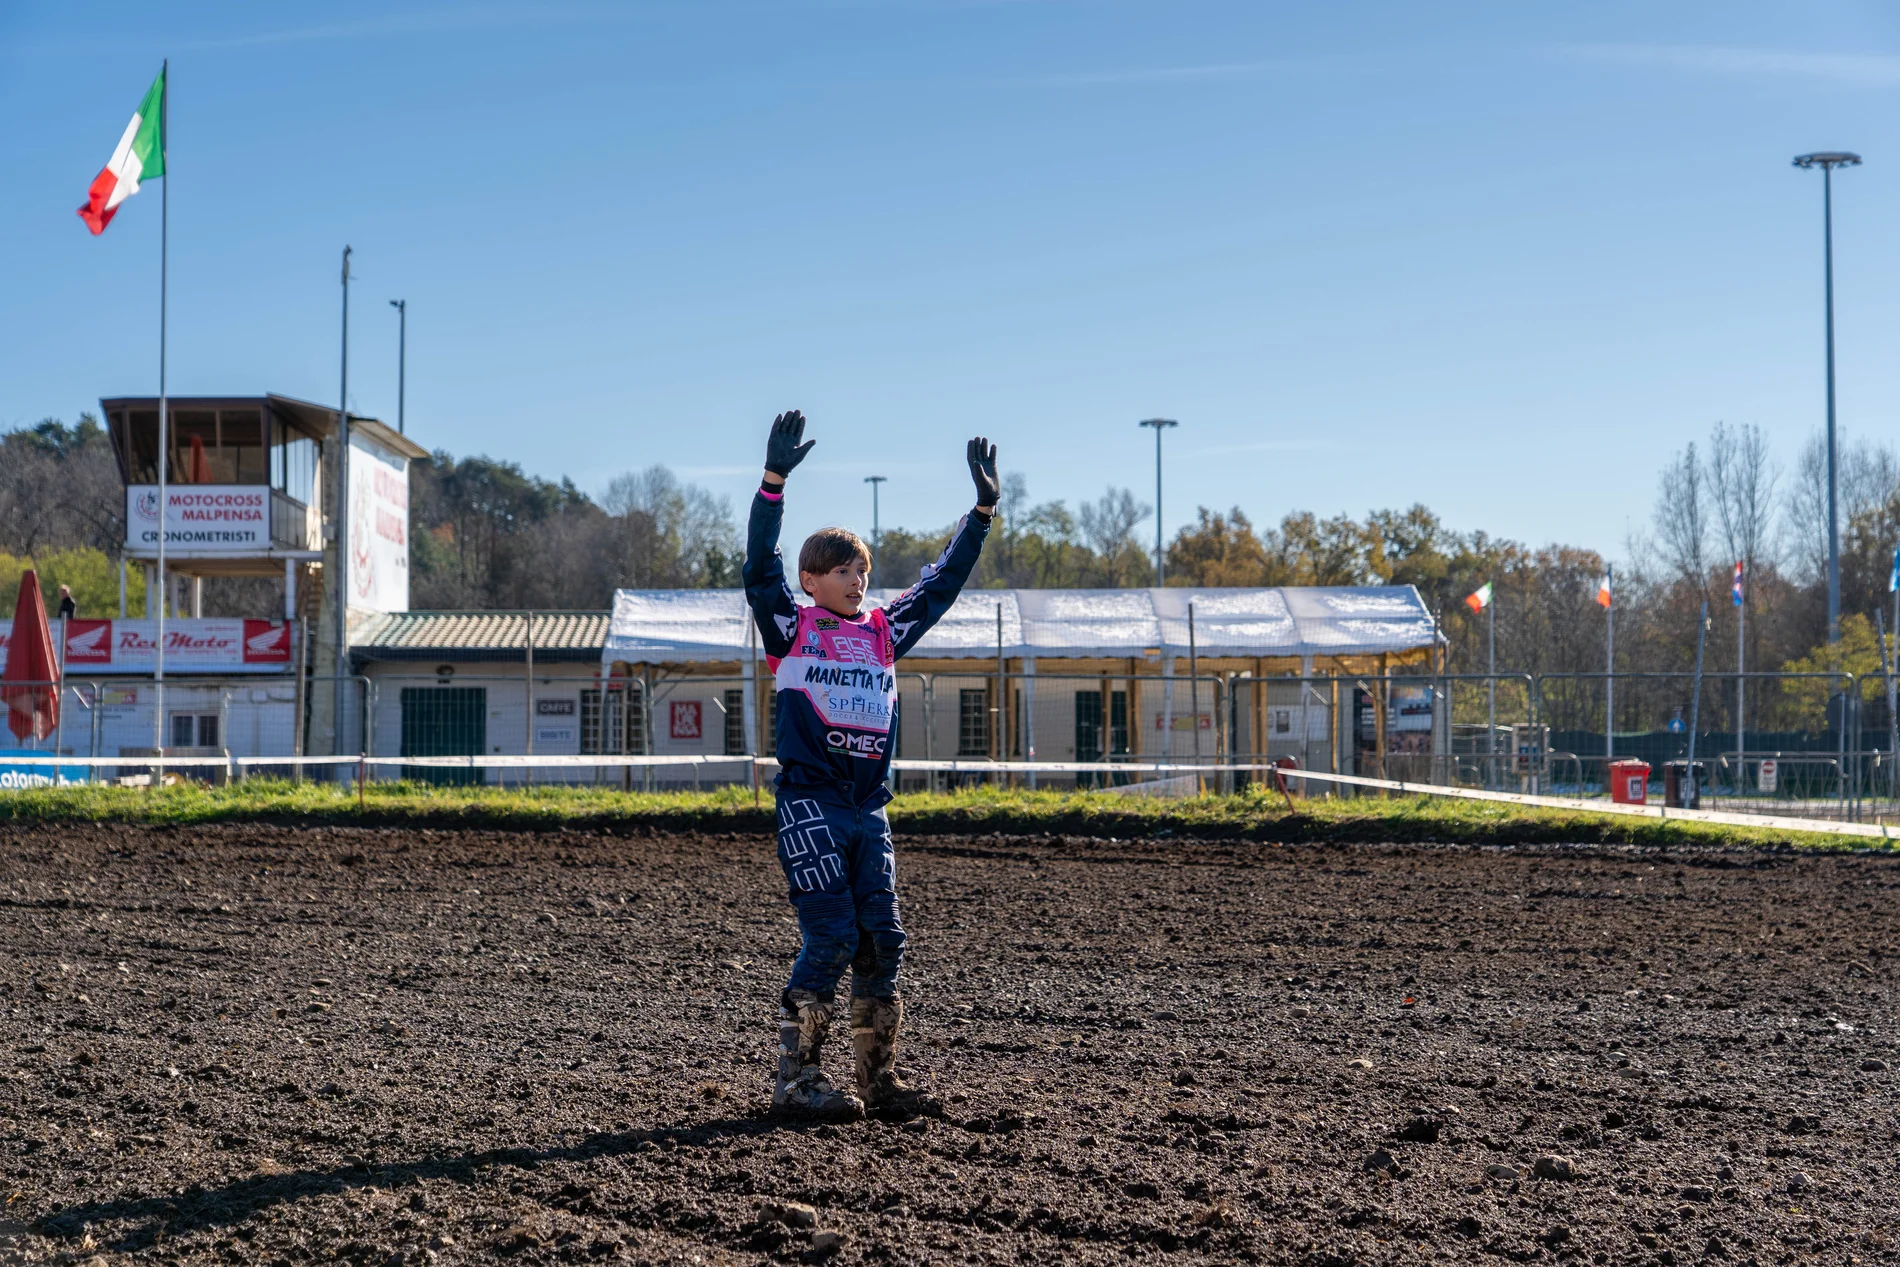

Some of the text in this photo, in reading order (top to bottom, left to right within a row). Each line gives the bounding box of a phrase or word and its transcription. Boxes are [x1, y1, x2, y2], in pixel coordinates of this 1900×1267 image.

[168, 495, 263, 506] MOTOCROSS
[182, 510, 262, 521] MALPENSA
[804, 666, 874, 690] MANETTA
[829, 695, 890, 716] SPHERA
